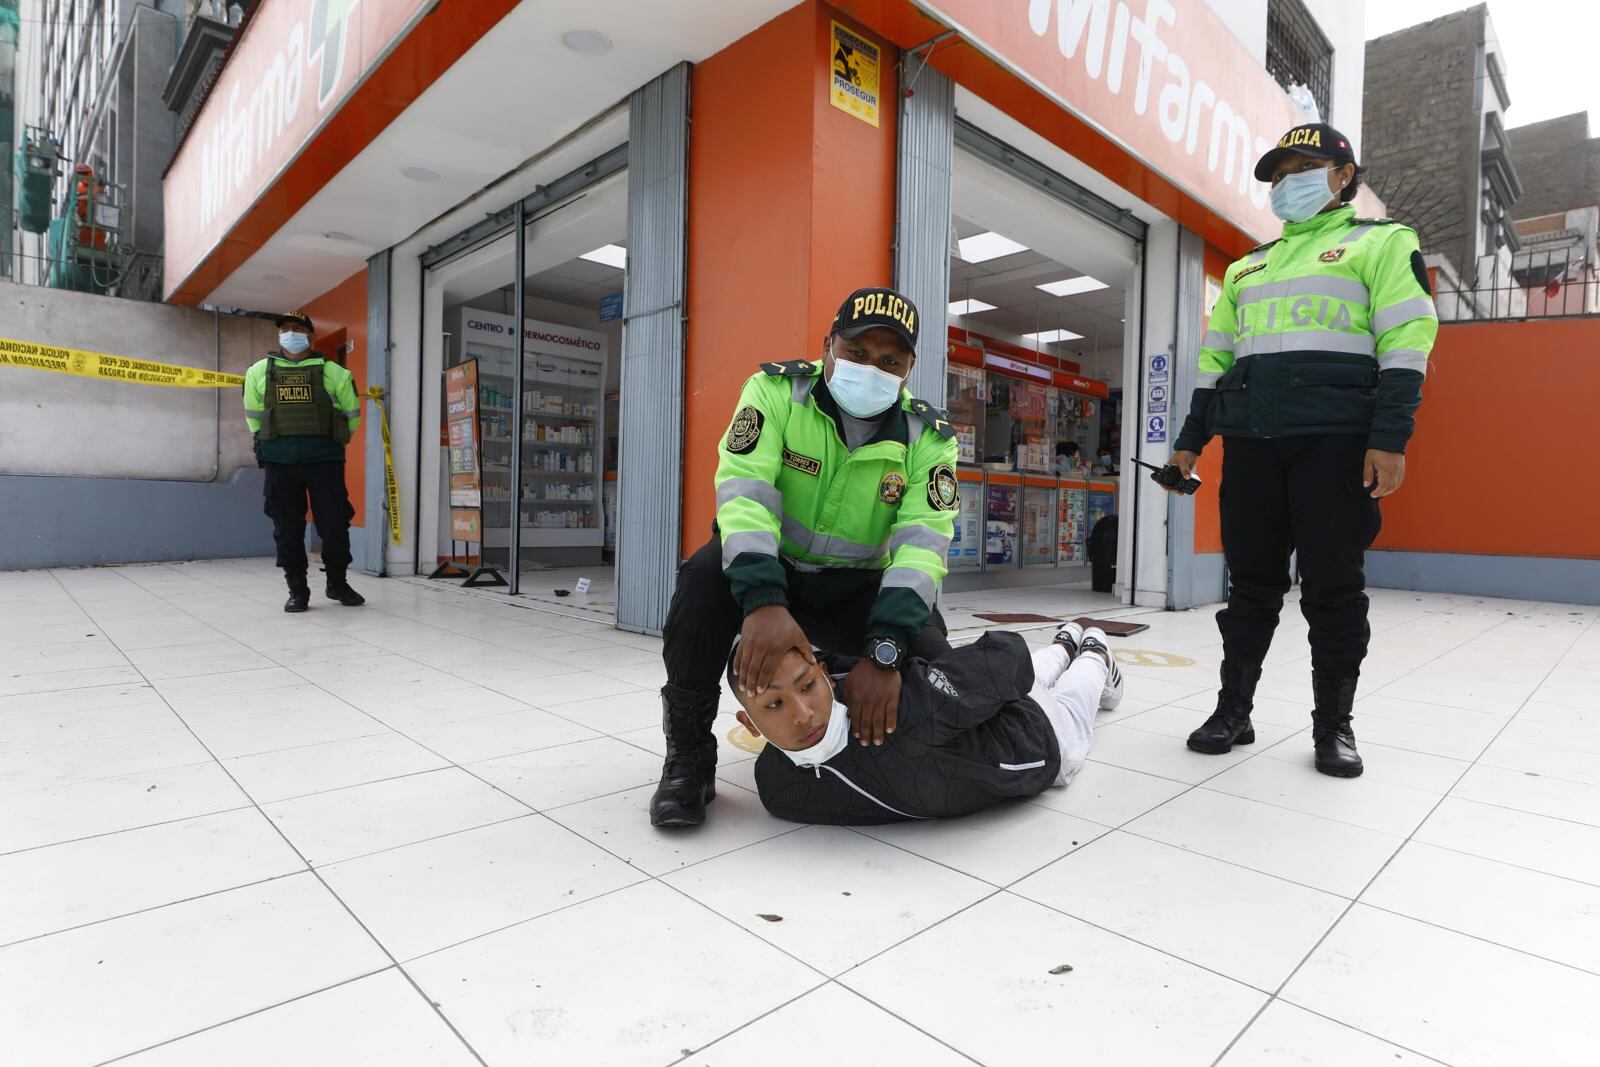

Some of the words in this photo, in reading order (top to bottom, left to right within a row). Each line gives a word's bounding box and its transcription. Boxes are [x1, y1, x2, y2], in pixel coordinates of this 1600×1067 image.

[834, 77, 877, 105] PROSEGUR
[200, 22, 304, 233] Mifarma
[1277, 128, 1321, 148] LICIA
[852, 293, 915, 335] POLICIA
[1236, 296, 1352, 337] LICIA
[467, 319, 503, 334] CENTRO
[523, 329, 601, 351] DERMOCOSMÉTICO
[279, 386, 310, 401] POLICIA
